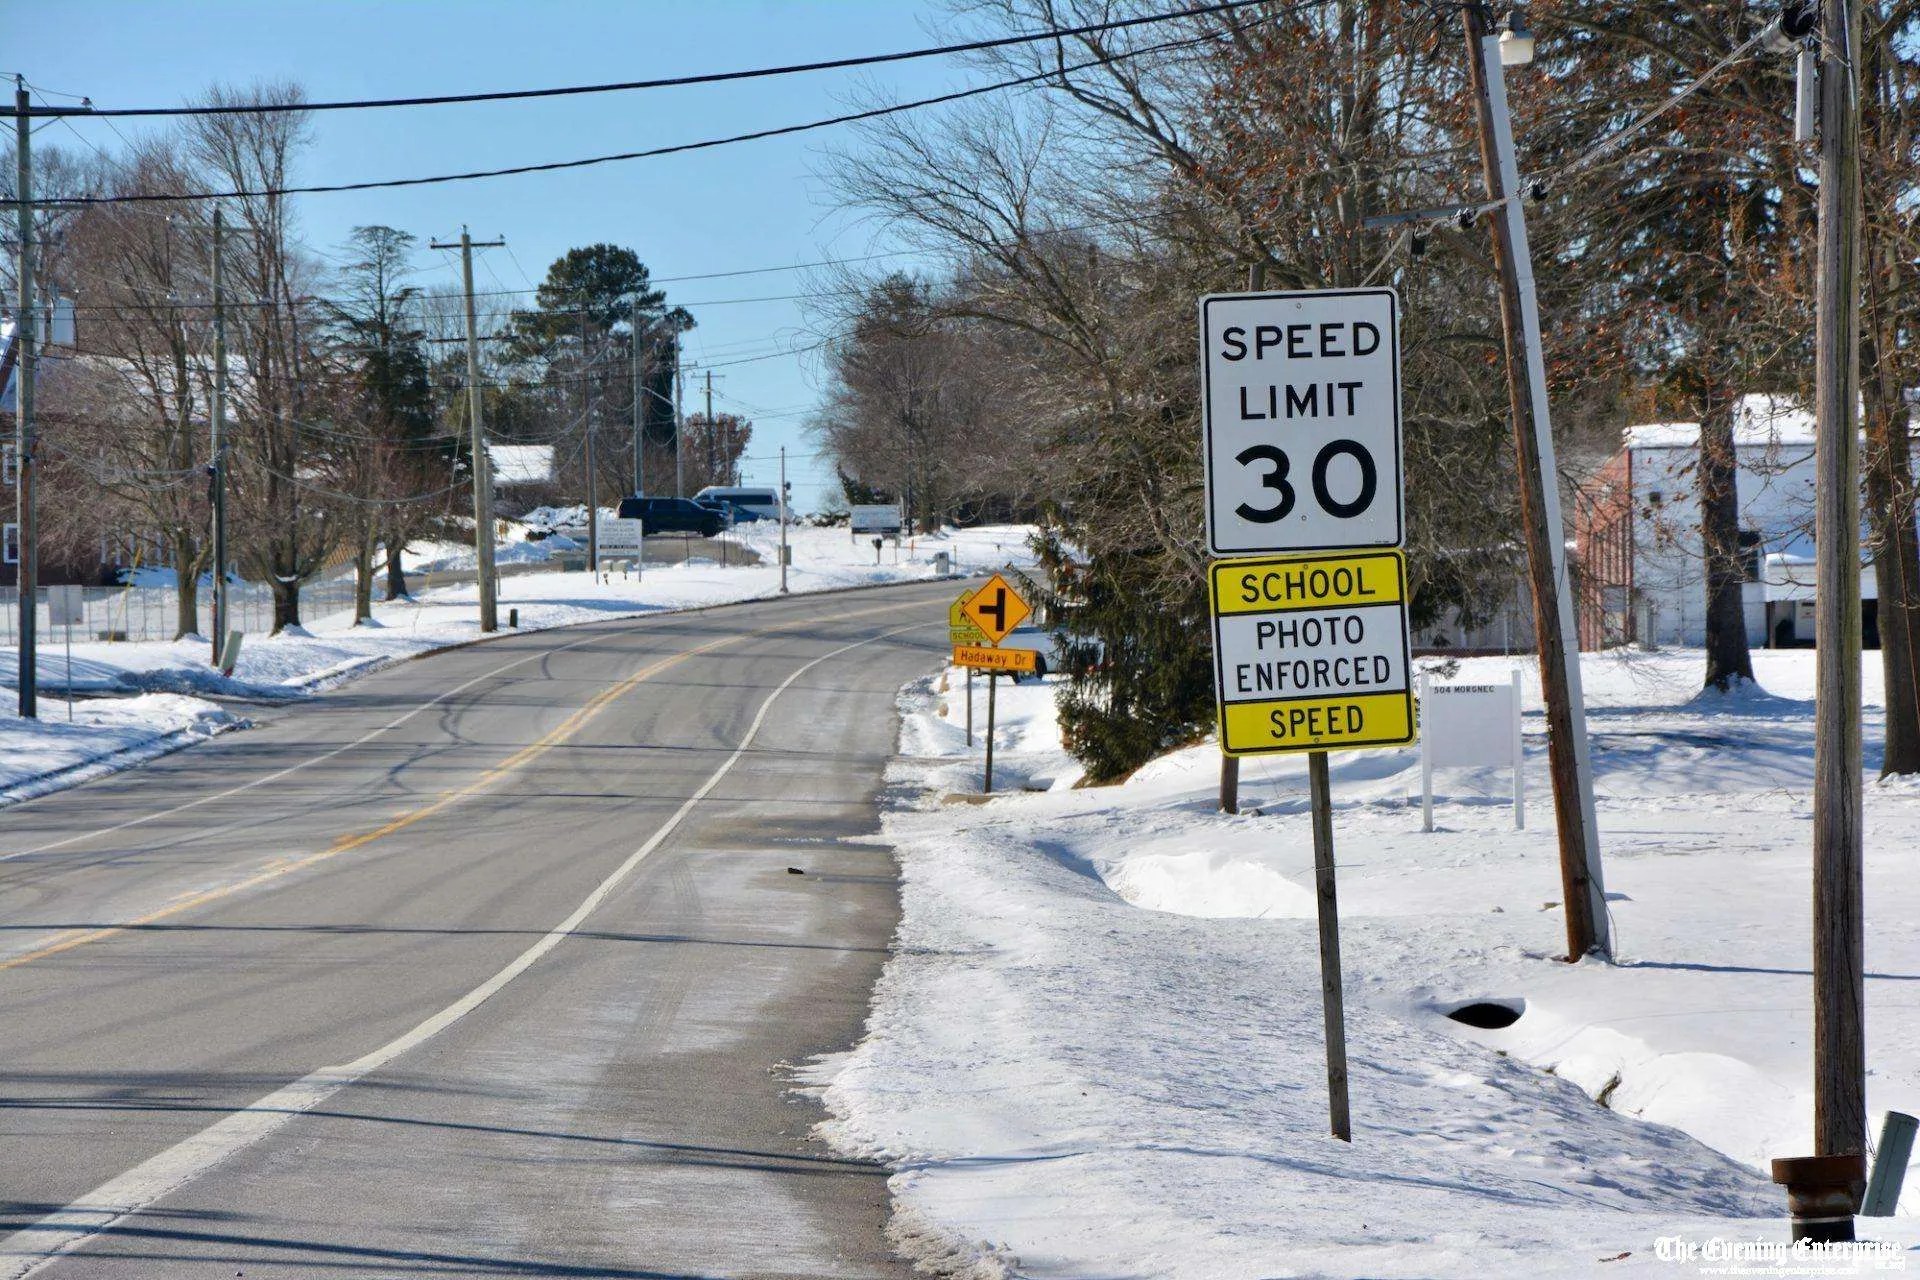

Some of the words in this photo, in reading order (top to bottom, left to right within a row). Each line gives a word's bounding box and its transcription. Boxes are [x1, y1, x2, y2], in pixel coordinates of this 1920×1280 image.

[1221, 321, 1380, 361] SPEED
[1240, 381, 1363, 420] LIMIT
[1234, 438, 1377, 524] 30
[1241, 567, 1376, 602] SCHOOL
[1256, 615, 1364, 650] PHOTO
[961, 650, 1007, 666] Hadaway
[1014, 653, 1027, 665] Dr
[1236, 655, 1390, 692] ENFORCED
[1433, 685, 1451, 695] 504
[1270, 705, 1363, 738] SPEED
